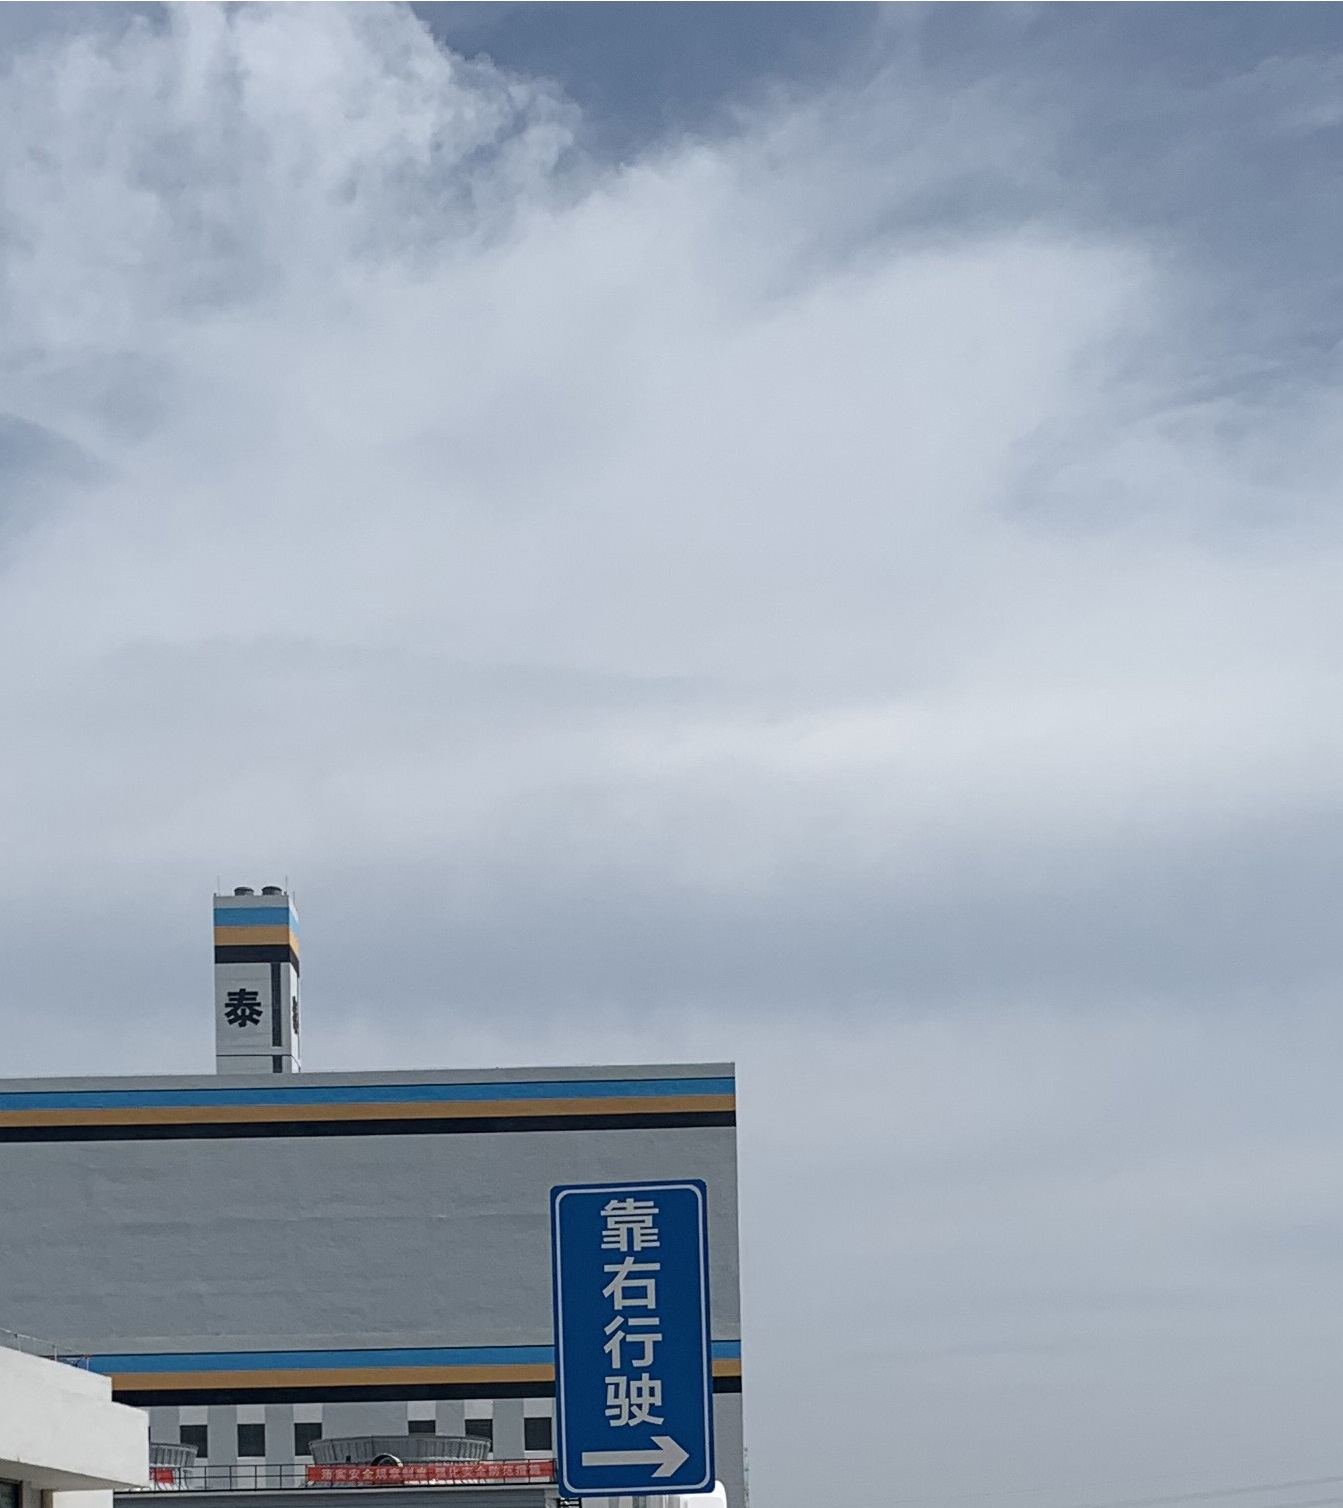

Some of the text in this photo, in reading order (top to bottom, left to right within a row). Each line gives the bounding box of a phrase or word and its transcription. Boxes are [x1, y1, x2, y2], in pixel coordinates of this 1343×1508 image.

[225, 988, 263, 1028] 泰
[600, 1198, 664, 1428] 靠右行驶
